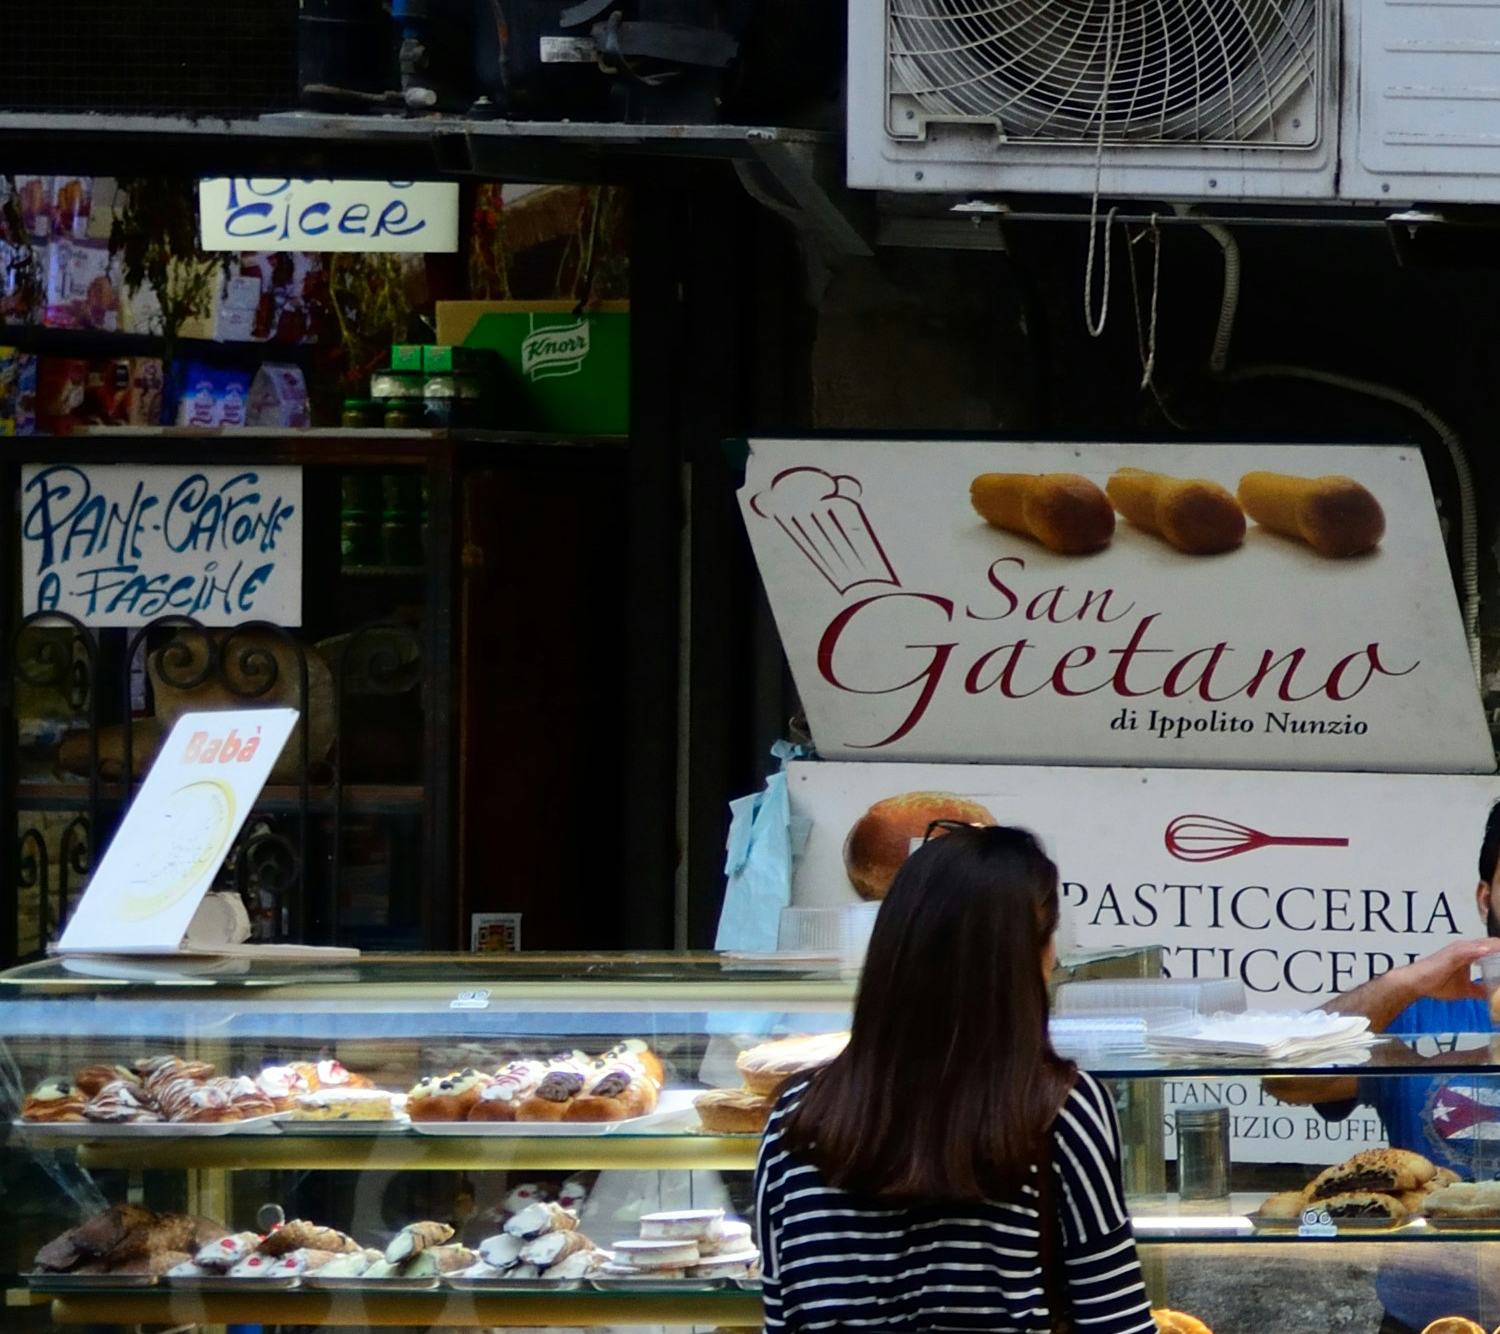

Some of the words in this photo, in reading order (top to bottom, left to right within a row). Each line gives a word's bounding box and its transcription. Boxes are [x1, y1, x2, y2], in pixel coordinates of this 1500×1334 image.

[527, 329, 589, 361] Knorr
[966, 557, 1137, 624] San
[816, 593, 1420, 748] Gaetano
[1110, 709, 1139, 733] di
[1147, 709, 1256, 740] Ippolito
[1265, 712, 1368, 737] Nunzio
